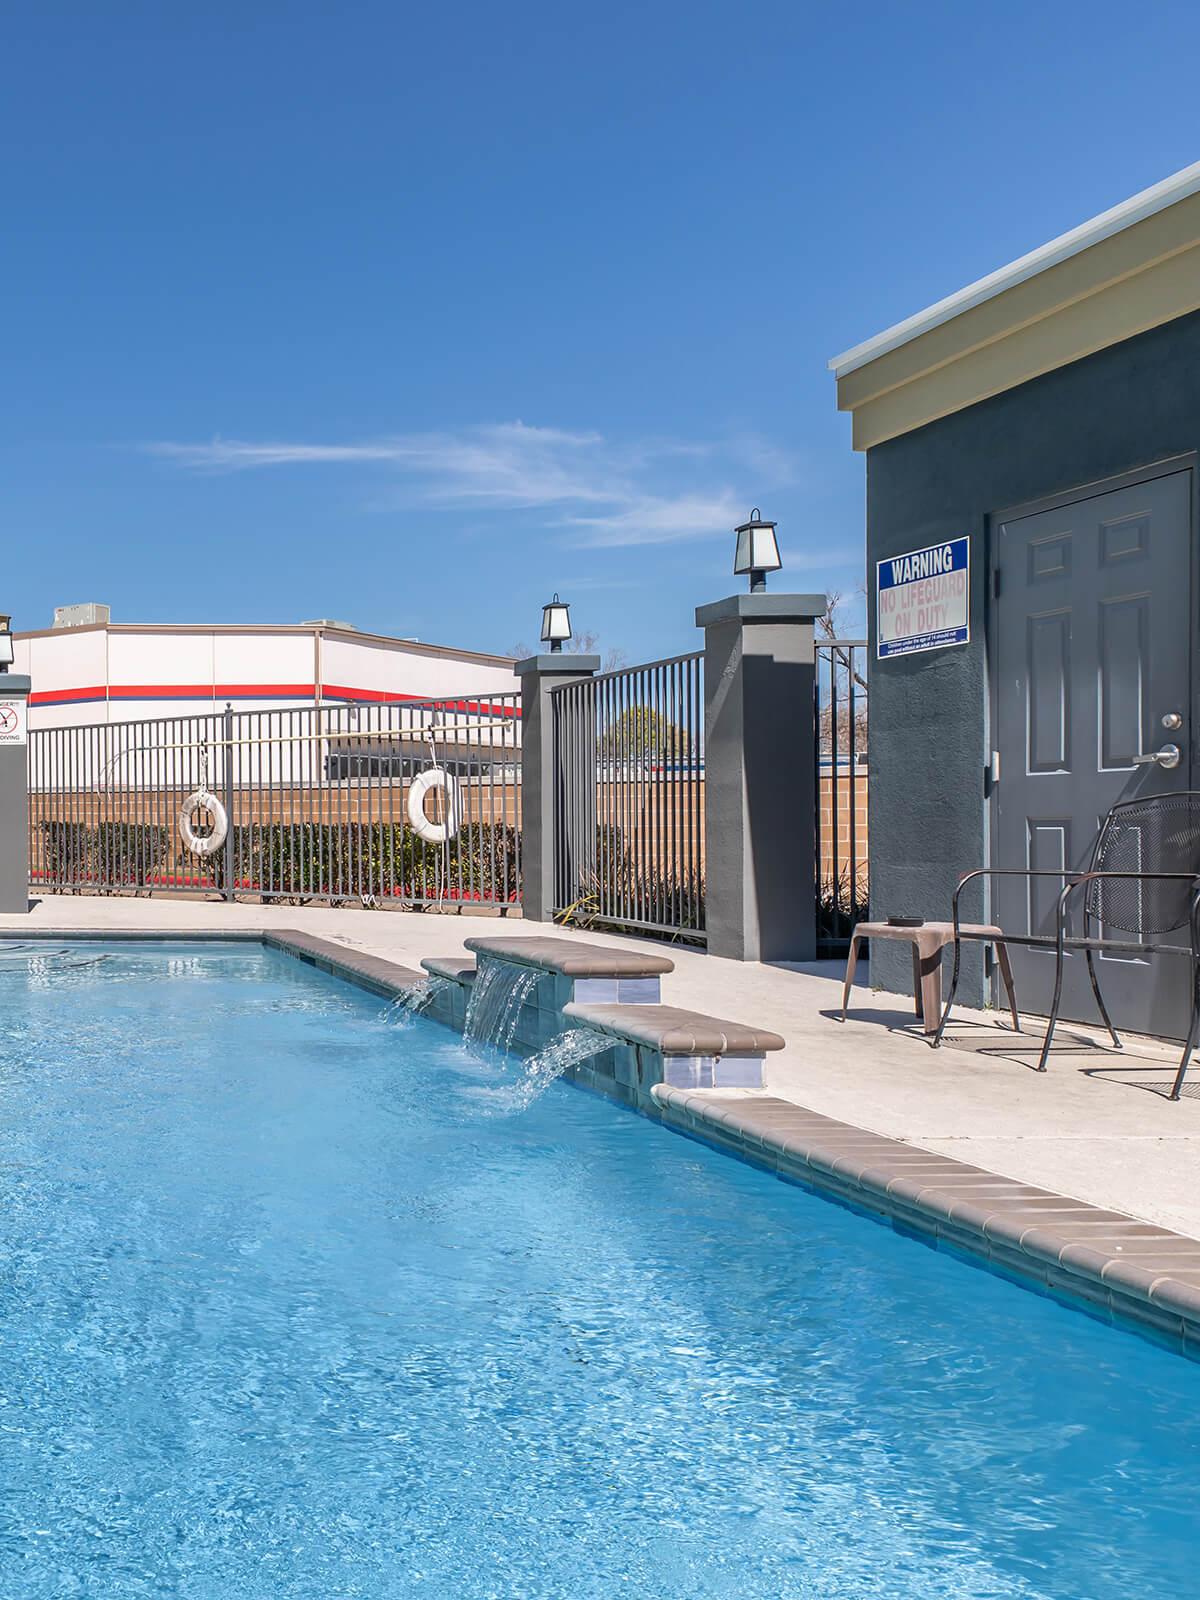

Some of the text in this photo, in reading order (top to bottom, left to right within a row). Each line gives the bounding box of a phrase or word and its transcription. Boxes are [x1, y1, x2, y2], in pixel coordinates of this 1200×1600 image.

[892, 545, 952, 584] WARNING
[881, 573, 964, 614] NO LIFEGUARD
[895, 603, 948, 637] ON DUTY
